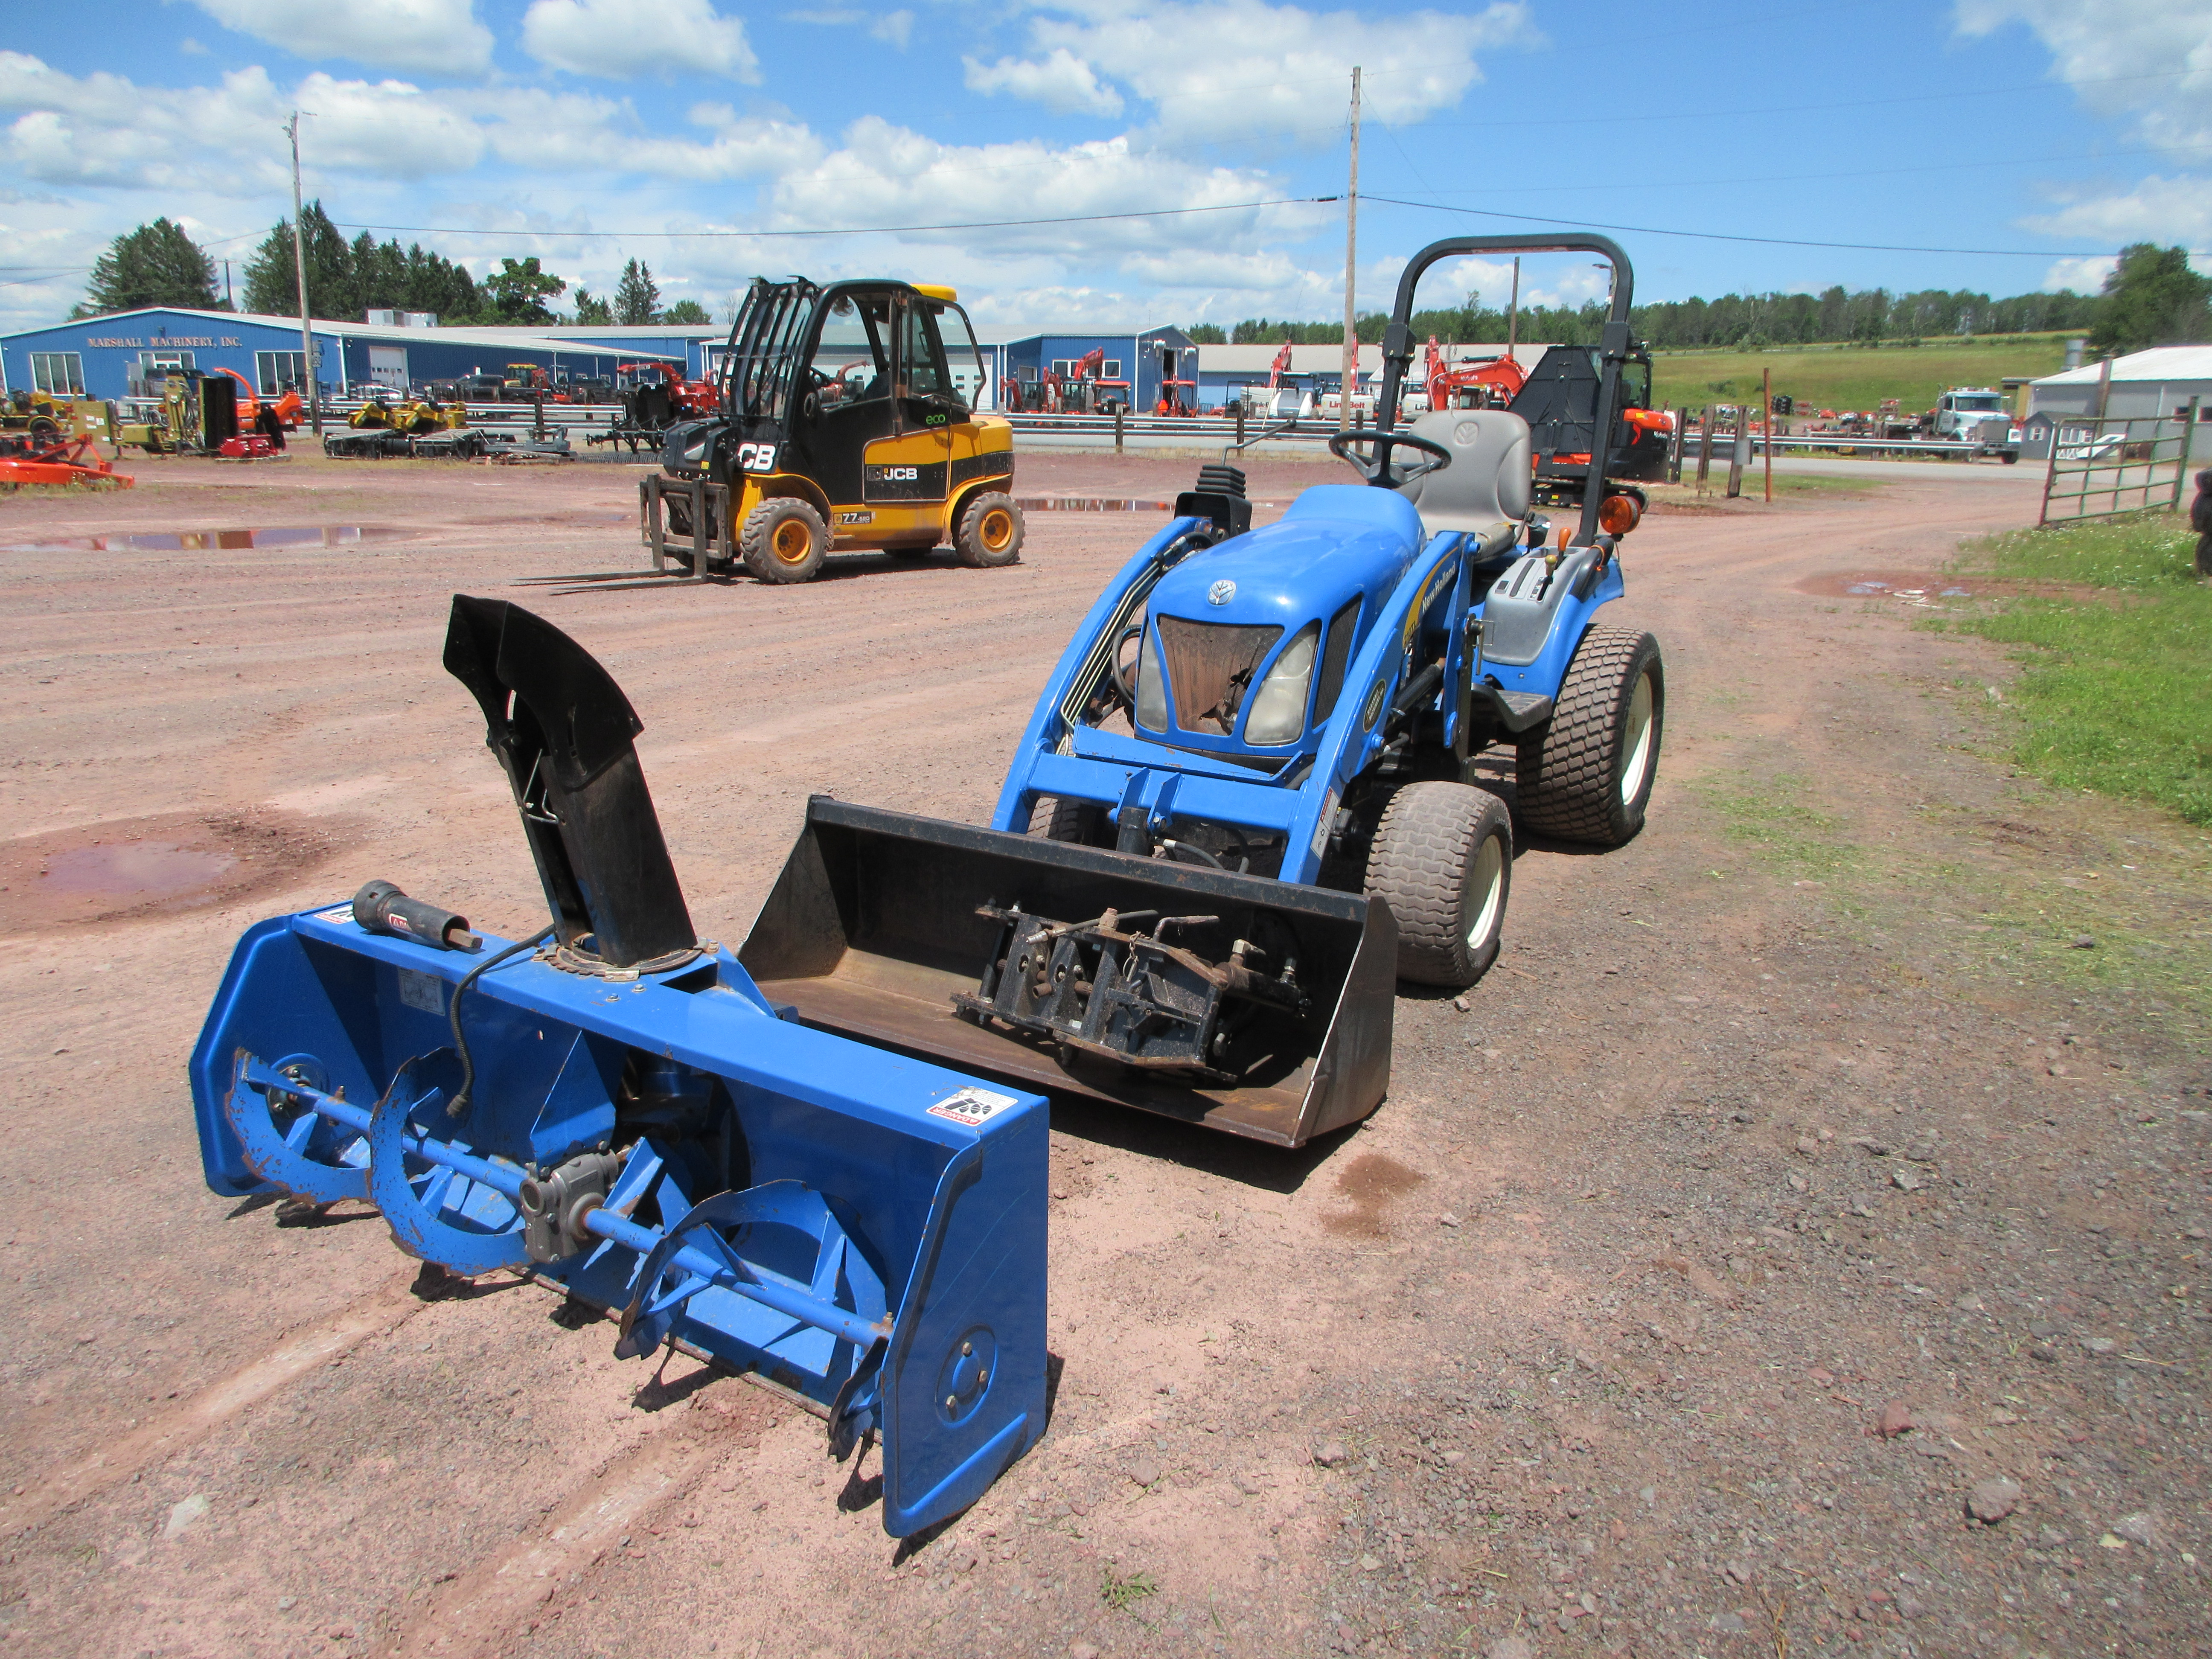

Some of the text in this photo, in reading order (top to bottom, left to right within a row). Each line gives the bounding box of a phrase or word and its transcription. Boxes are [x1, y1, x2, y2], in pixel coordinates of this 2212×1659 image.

[88, 337, 242, 349] MARSHALL MACHINERY, INC.
[926, 414, 946, 425] eco
[737, 443, 776, 470] CB
[884, 468, 917, 480] JCB
[933, 1108, 970, 1121] DANGER
